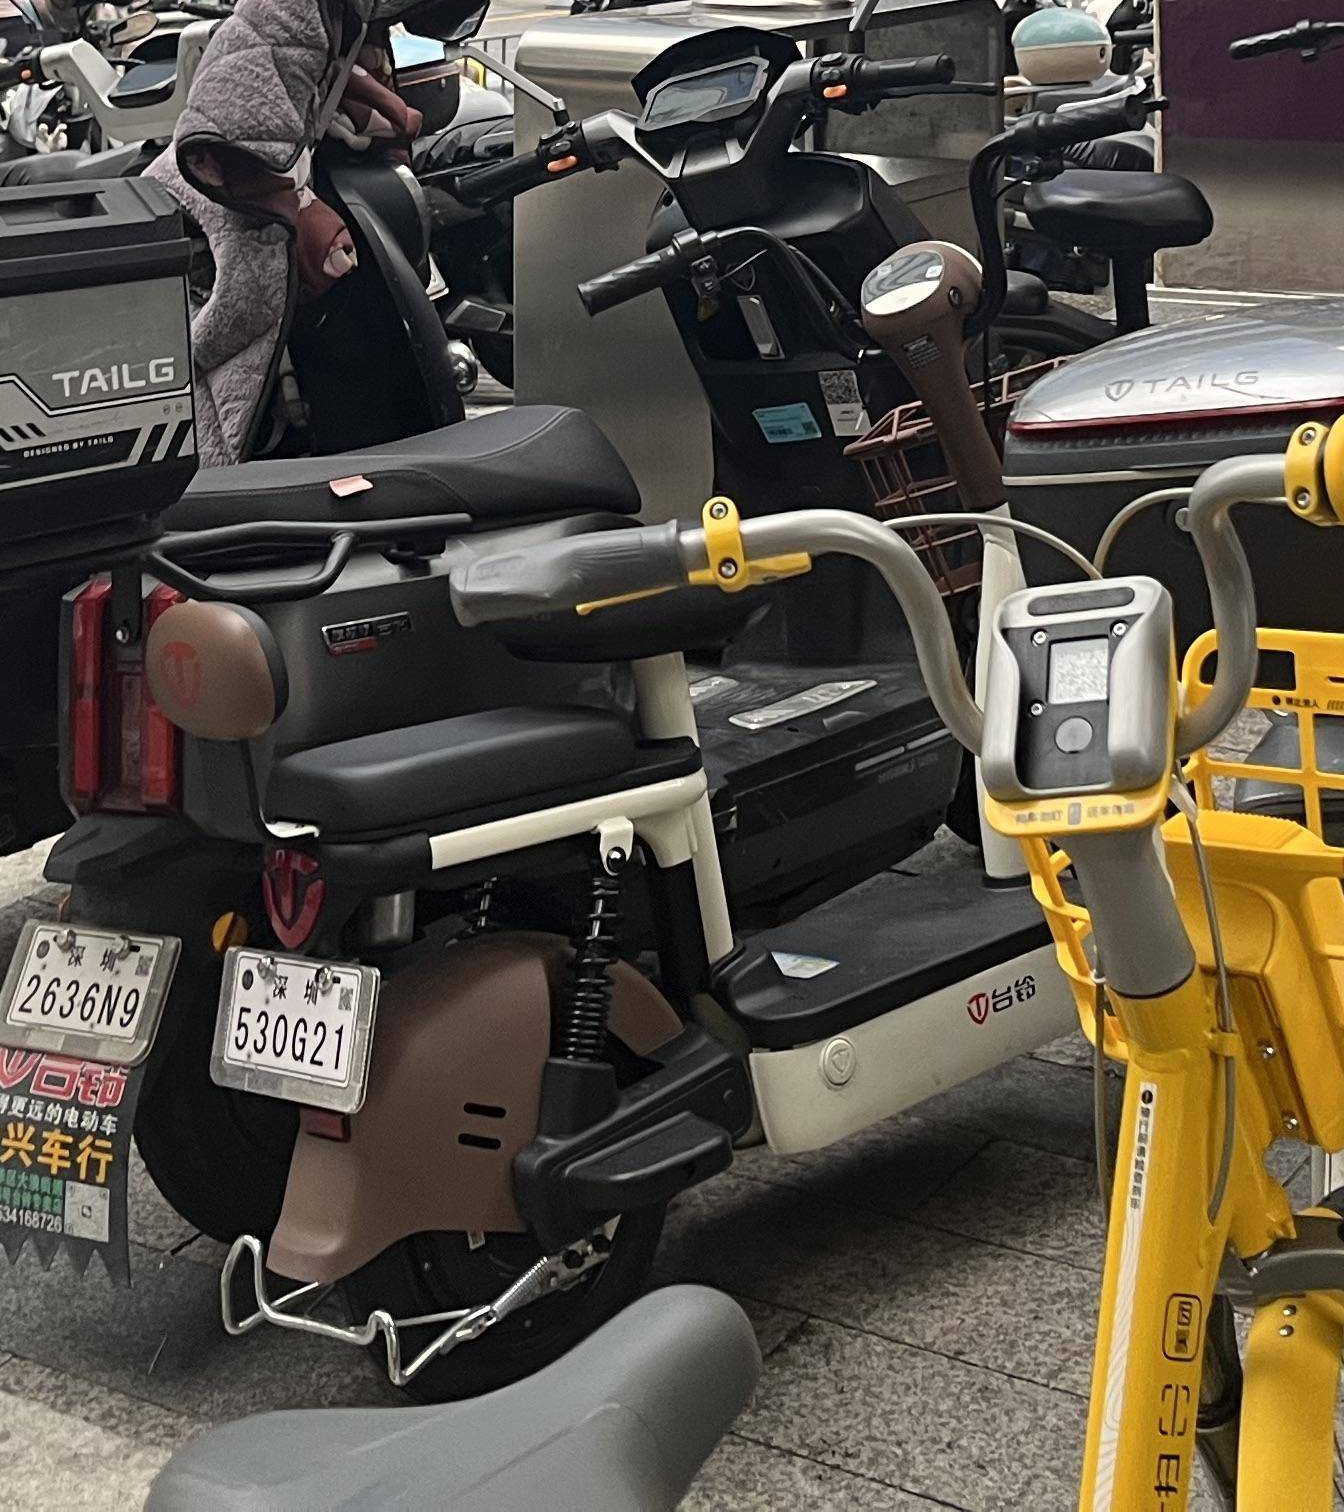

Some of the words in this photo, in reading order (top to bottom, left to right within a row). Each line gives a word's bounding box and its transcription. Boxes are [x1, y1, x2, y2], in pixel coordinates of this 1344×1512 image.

[52, 356, 175, 398] TAILG
[1143, 370, 1259, 394] TAILG
[67, 944, 118, 972] 深圳
[18, 974, 141, 1028] 2636N9
[272, 975, 318, 1006] 深圳
[991, 974, 1036, 1013] 台铃
[234, 1006, 345, 1071] 530G21
